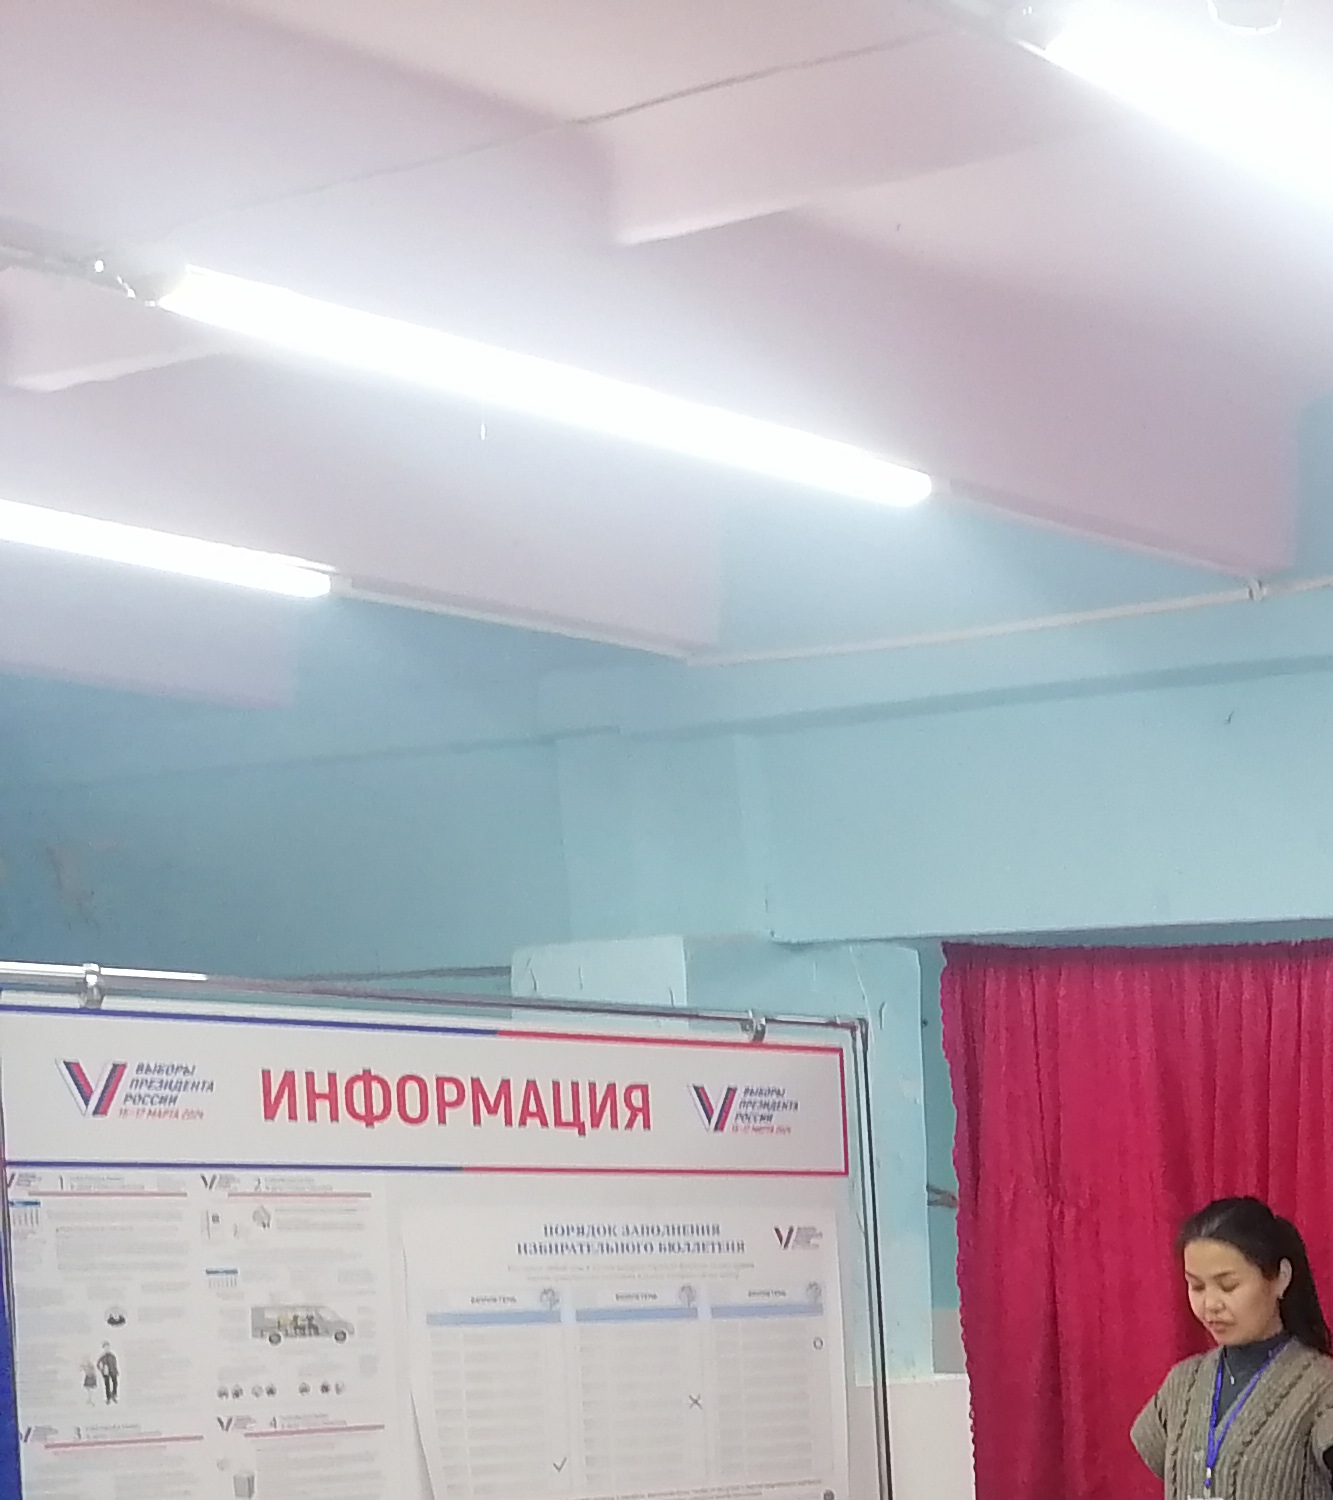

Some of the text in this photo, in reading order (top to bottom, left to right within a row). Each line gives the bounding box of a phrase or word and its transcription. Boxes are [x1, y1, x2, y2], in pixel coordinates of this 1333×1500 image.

[135, 1062, 196, 1076] ВЫБОРЫ
[129, 1079, 215, 1093] ПРЕЗИДЕНТА
[123, 1093, 179, 1106] РОССИИ
[260, 1066, 652, 1138] ИНФОРМАЦИЯ
[146, 1108, 180, 1120] МАРТА
[542, 1223, 721, 1238] ПОРЯДОК ЗАПОЛНЕНИЯ
[516, 1240, 746, 1256] ИЗБИРАТЕЛЬНОГО БЮЛЛЕТЕНЯ
